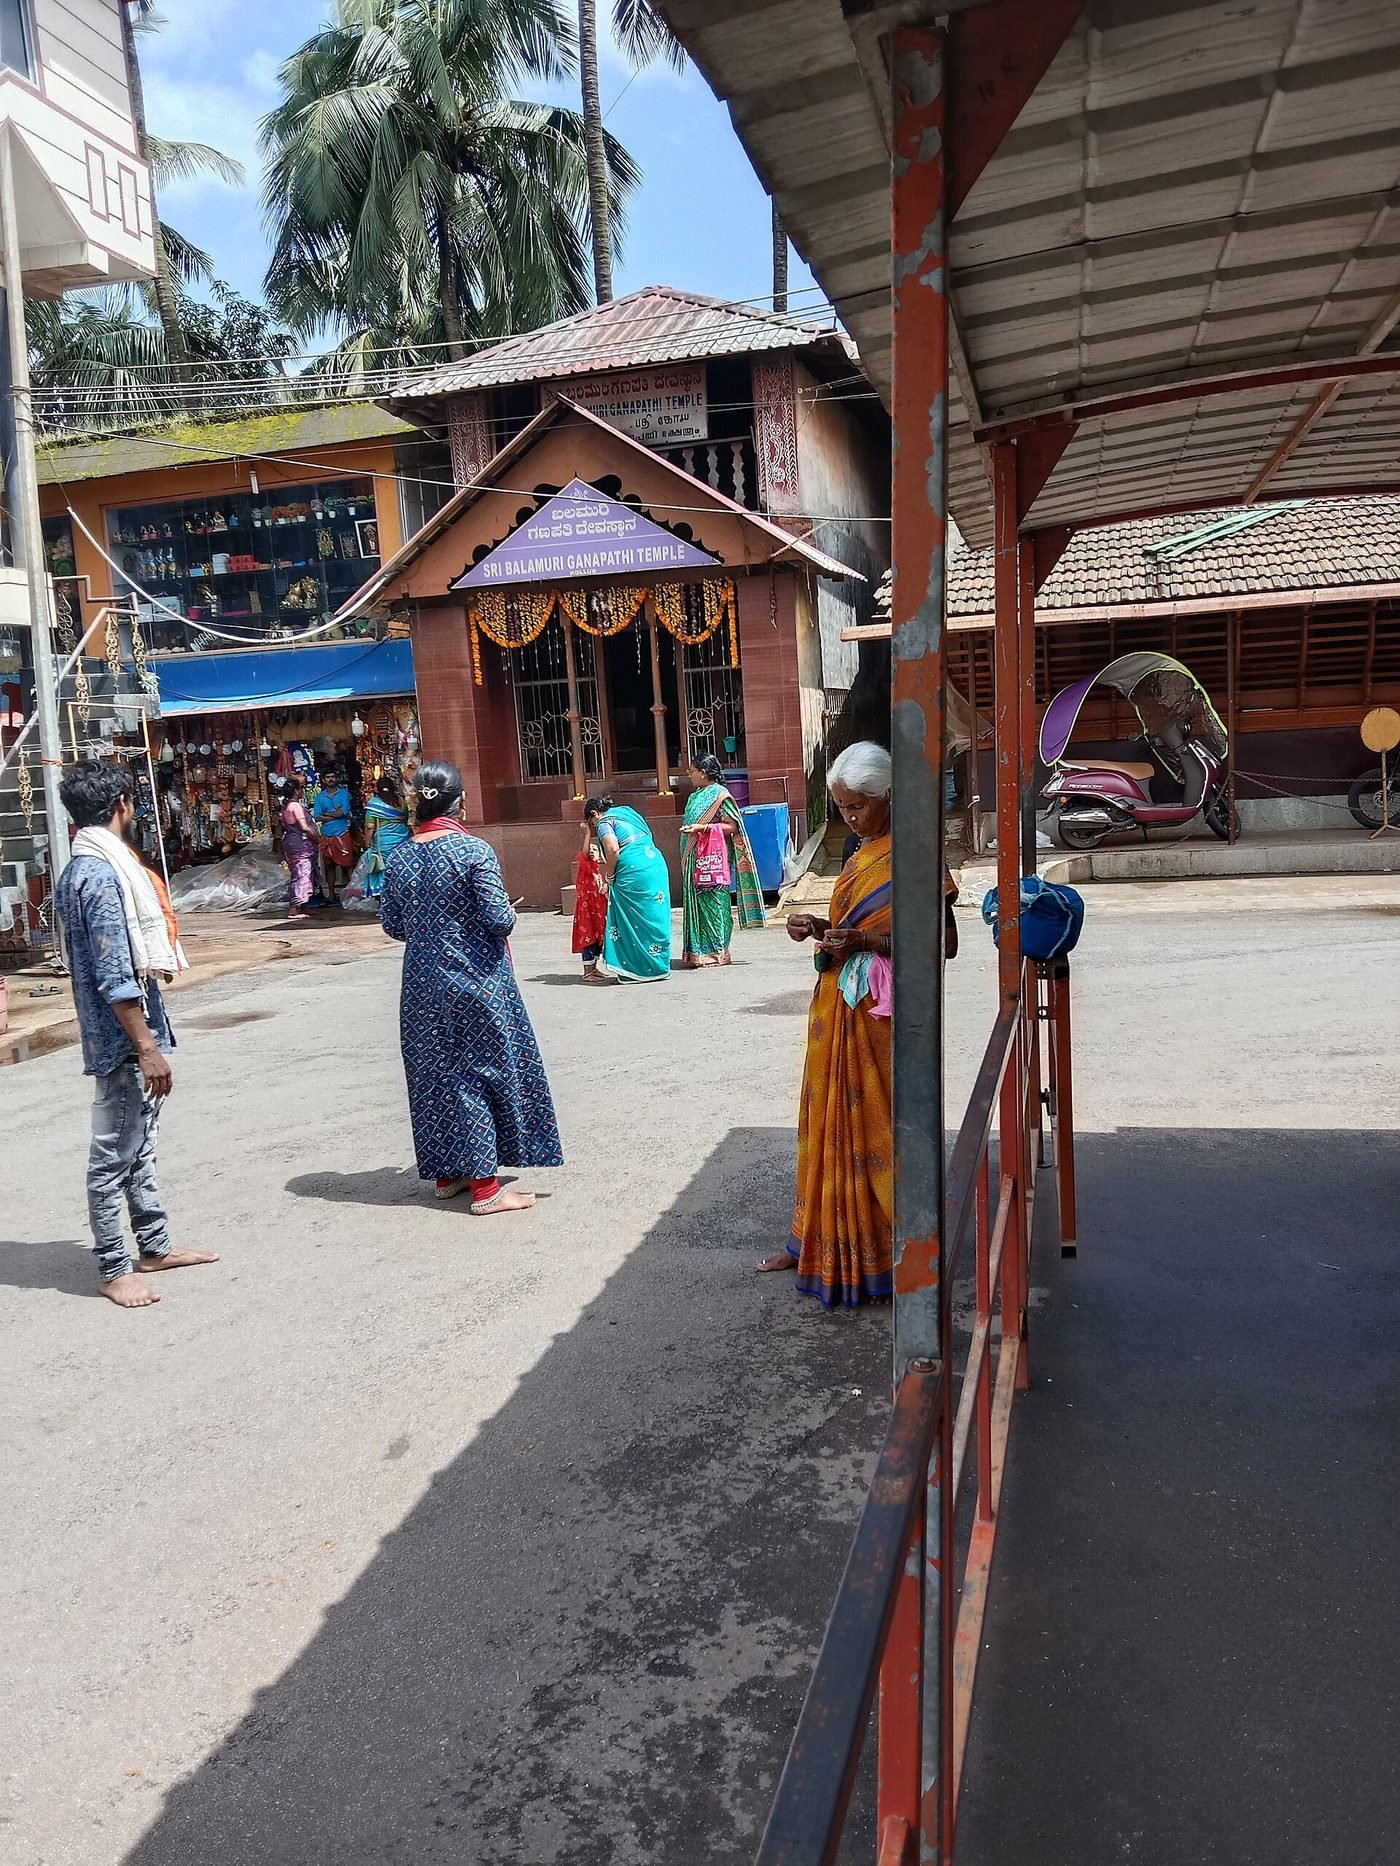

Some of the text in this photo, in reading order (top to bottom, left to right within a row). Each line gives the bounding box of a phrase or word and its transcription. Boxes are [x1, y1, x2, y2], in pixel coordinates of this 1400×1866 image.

[654, 369, 702, 393] ದೇವಸ್ಥಾನ
[609, 396, 663, 417] GANAPATHI
[665, 393, 703, 411] TEMPLE
[551, 503, 610, 521] ಬಲಮುರಿ
[527, 516, 637, 540] ಗಣಪತಿ ದೇವಸ್ಥಾನ
[483, 544, 685, 578] SRI BALAMURI GANAPATHI TEMPLE
[569, 569, 597, 577] KOLLUR
